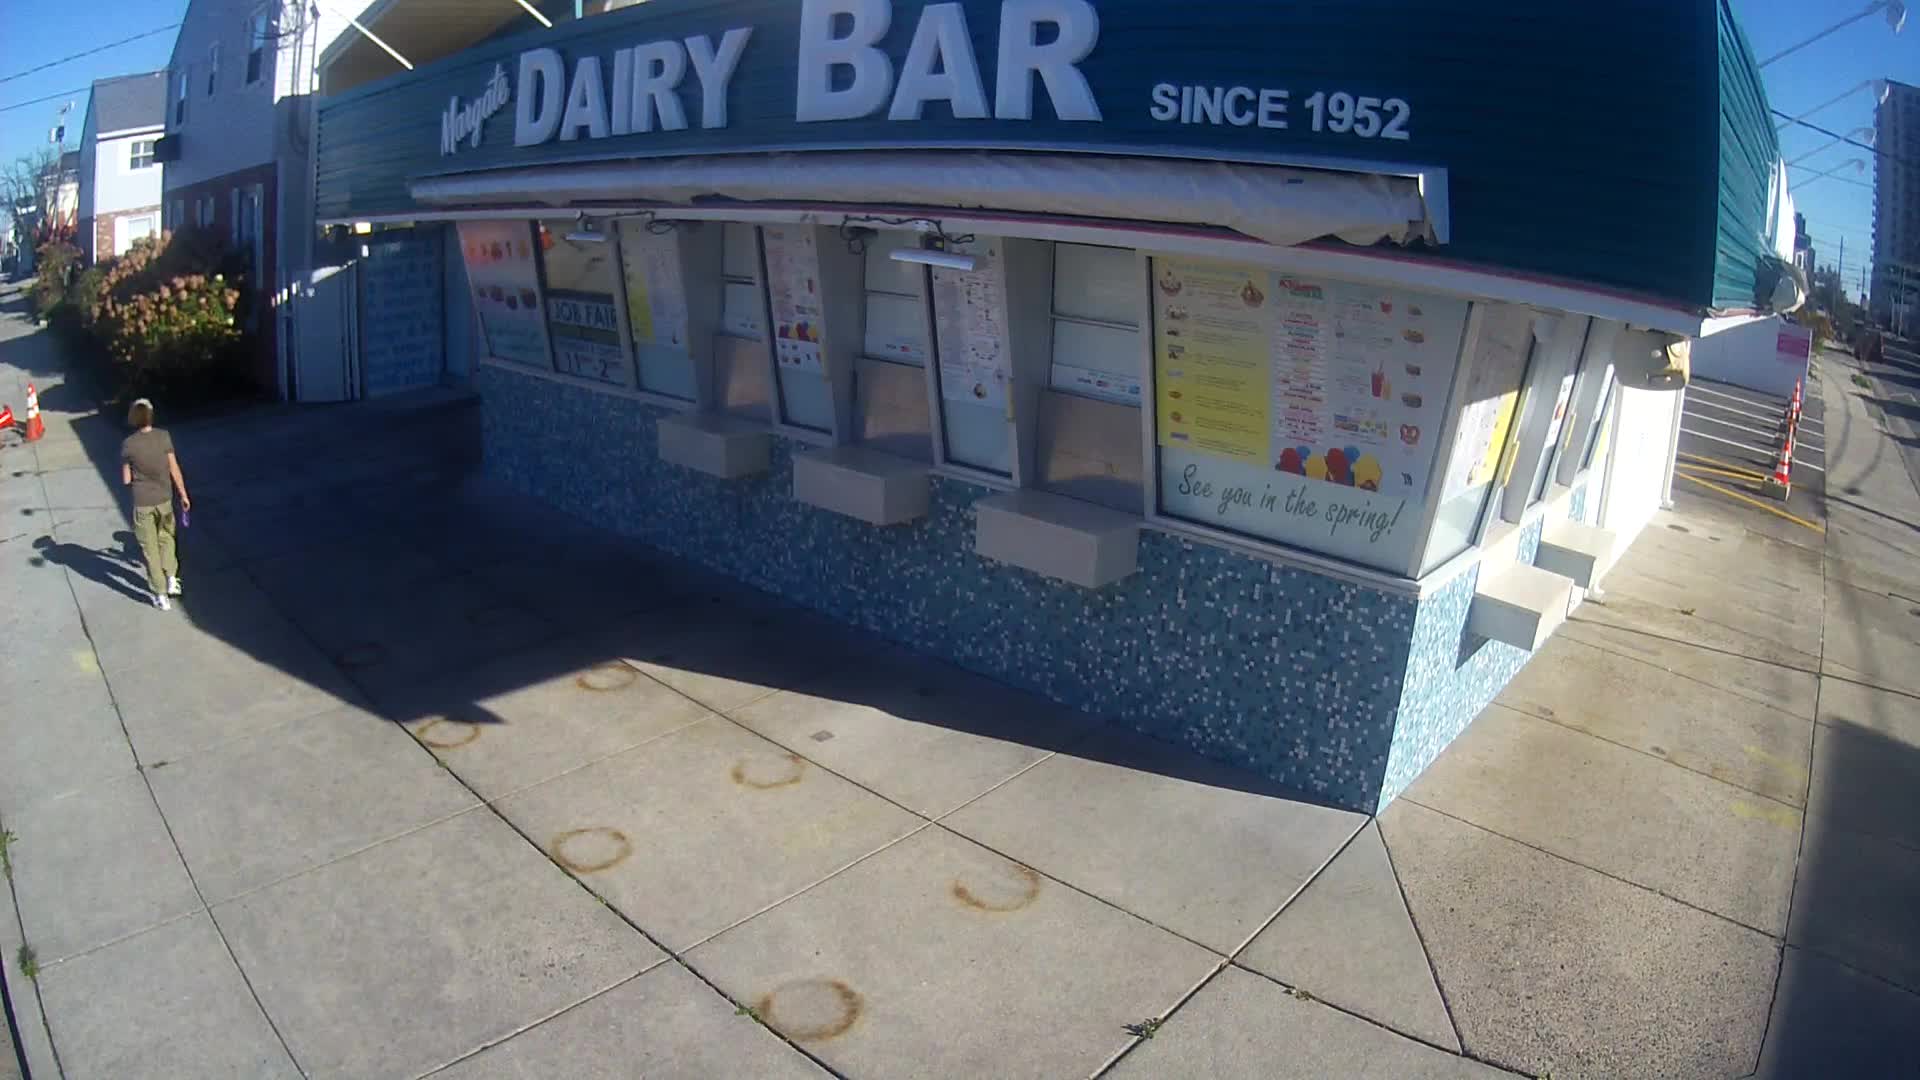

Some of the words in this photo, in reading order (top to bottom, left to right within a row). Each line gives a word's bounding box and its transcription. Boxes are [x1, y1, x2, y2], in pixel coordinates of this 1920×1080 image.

[513, 27, 754, 147] DAIRY
[796, 0, 1102, 122] BAR
[1150, 83, 1290, 129] SINCE
[1304, 91, 1411, 140] 1952
[1179, 463, 1213, 498] See
[1217, 485, 1252, 515] you
[1260, 484, 1277, 512] in
[1284, 484, 1318, 517] the
[1325, 498, 1406, 543] spring!
